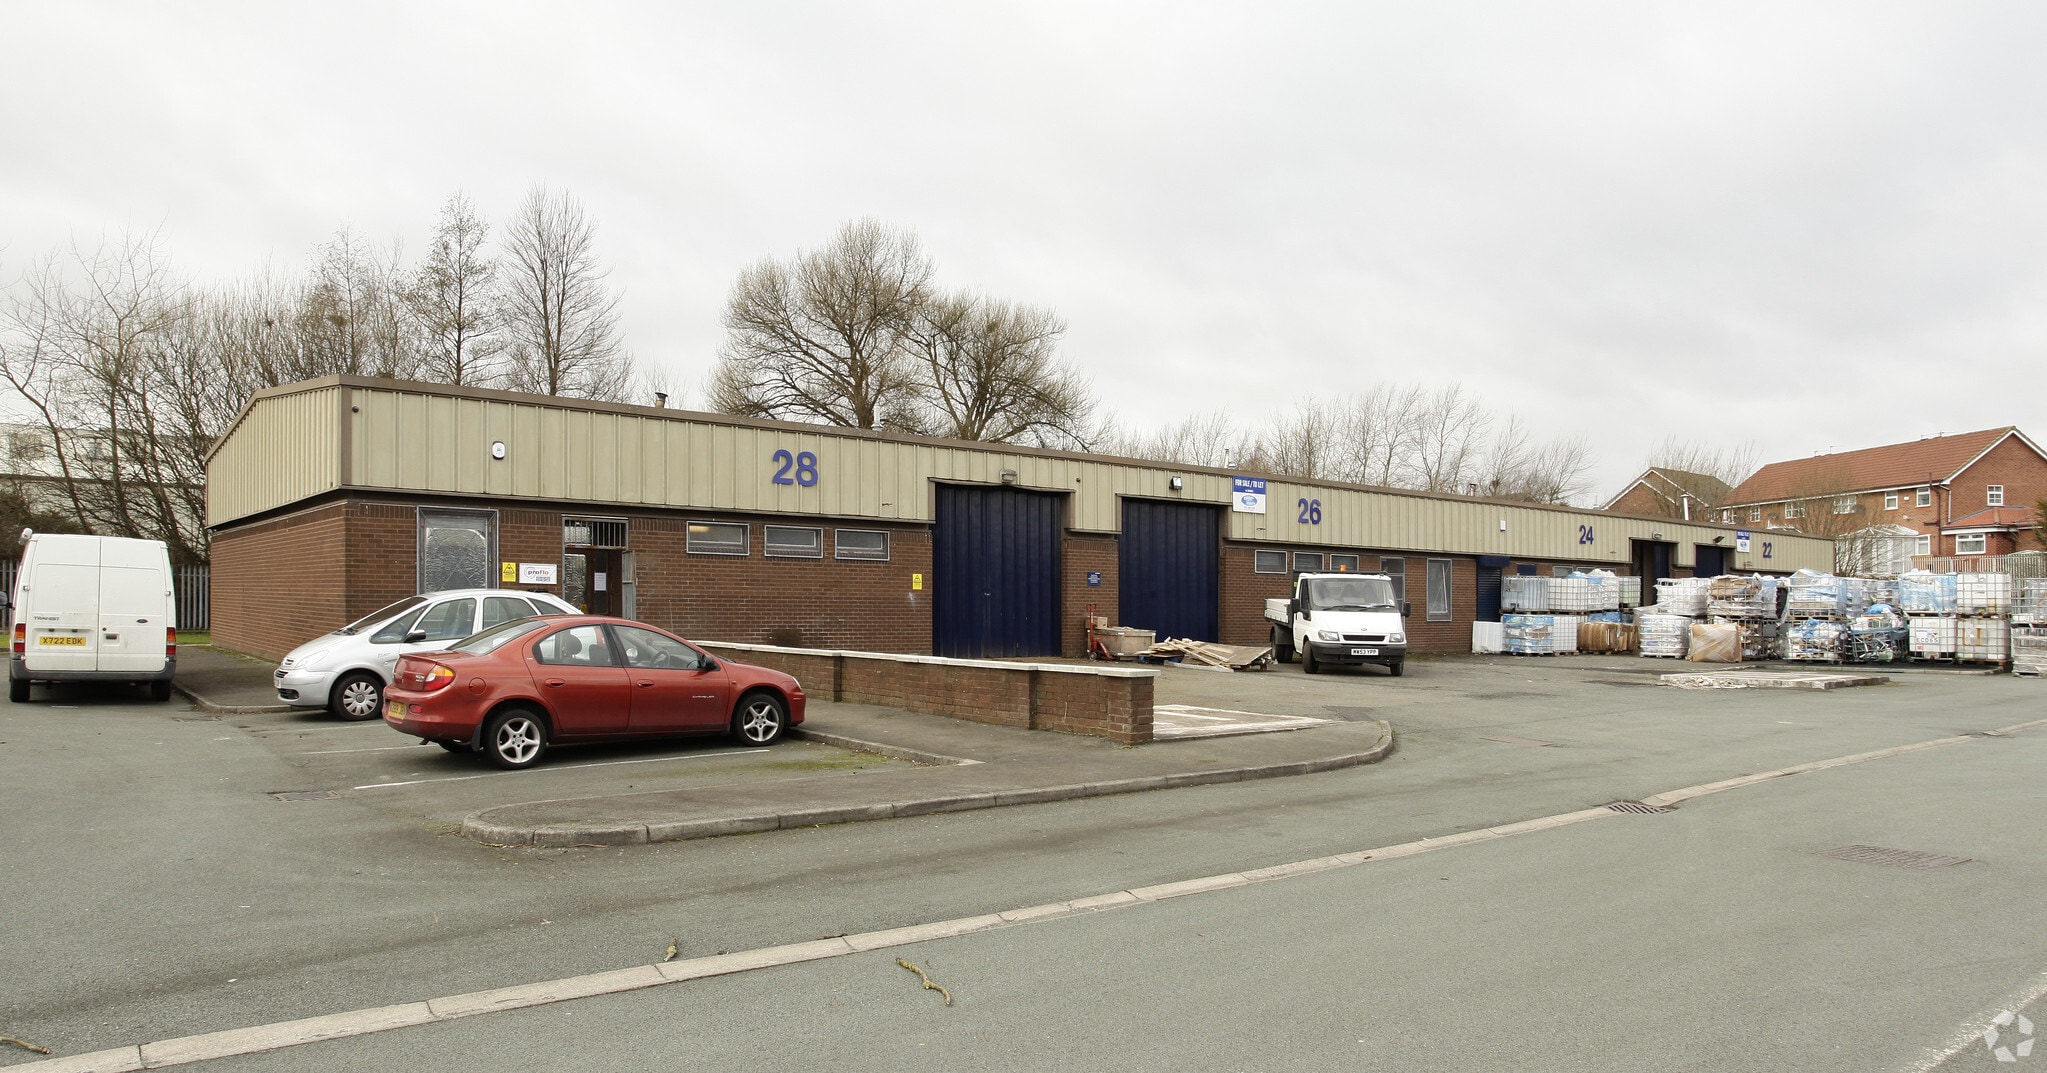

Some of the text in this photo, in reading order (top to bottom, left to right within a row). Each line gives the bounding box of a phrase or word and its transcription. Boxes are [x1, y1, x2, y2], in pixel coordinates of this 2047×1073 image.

[772, 449, 819, 487] 28
[1298, 498, 1322, 525] 26
[1579, 525, 1594, 545] 24
[1762, 542, 1772, 558] 22
[43, 637, 64, 645] X722
